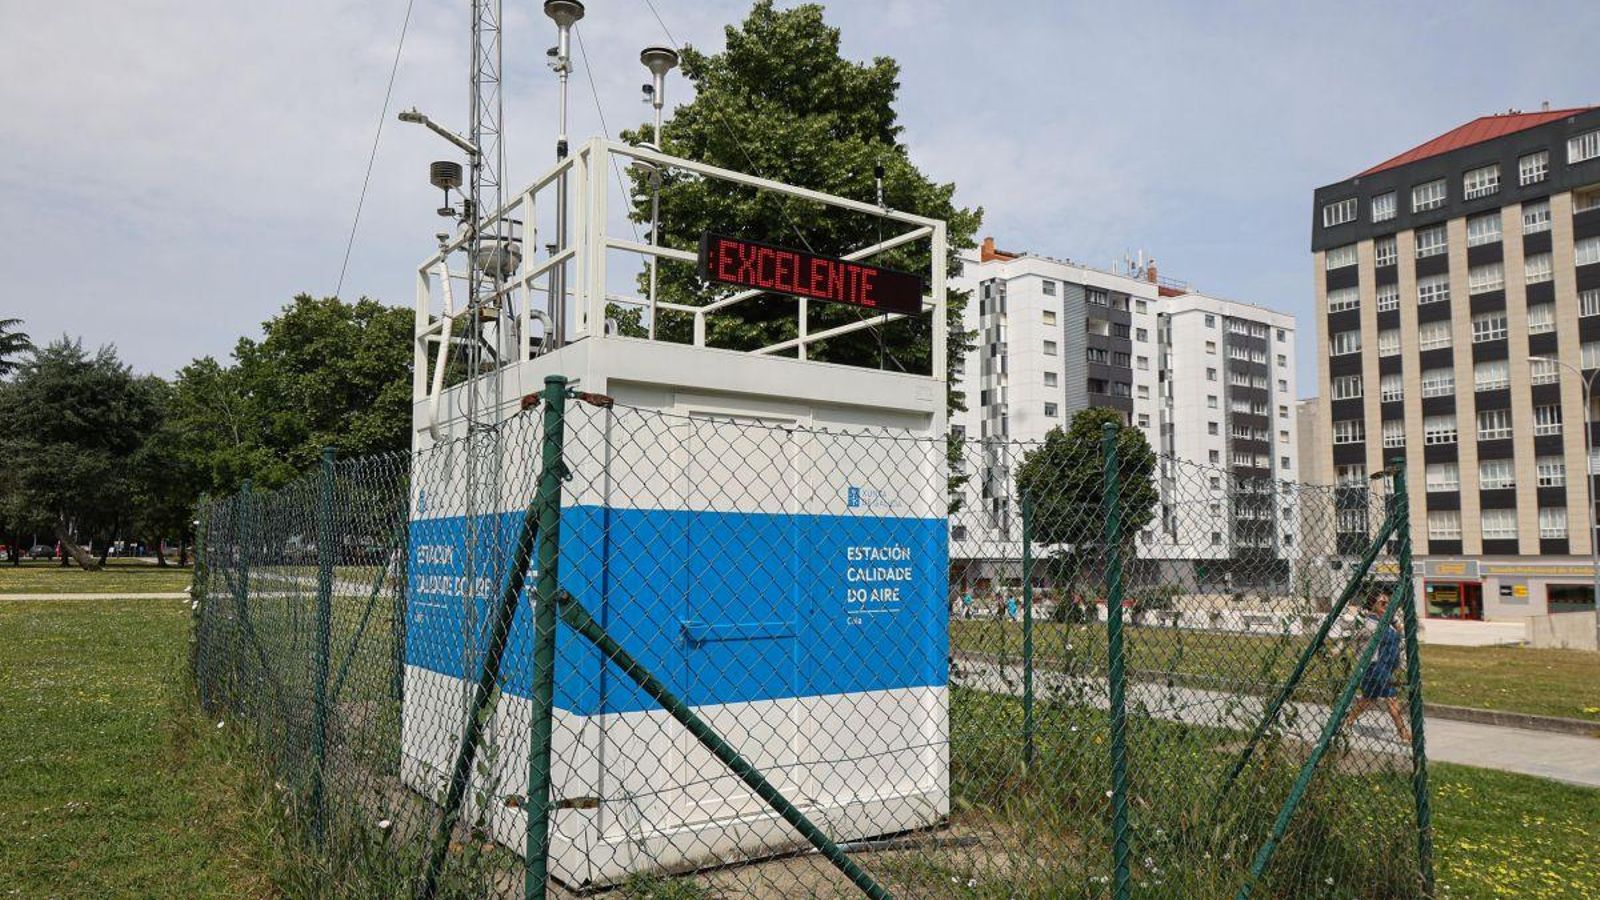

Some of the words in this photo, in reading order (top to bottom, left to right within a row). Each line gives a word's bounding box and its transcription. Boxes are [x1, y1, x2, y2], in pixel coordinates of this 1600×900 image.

[718, 240, 878, 306] EXCELENTE
[847, 543, 911, 560] ESTACIÓN
[847, 567, 913, 581] CALIDADE
[847, 589, 867, 603] DO
[870, 588, 900, 602] AIRE
